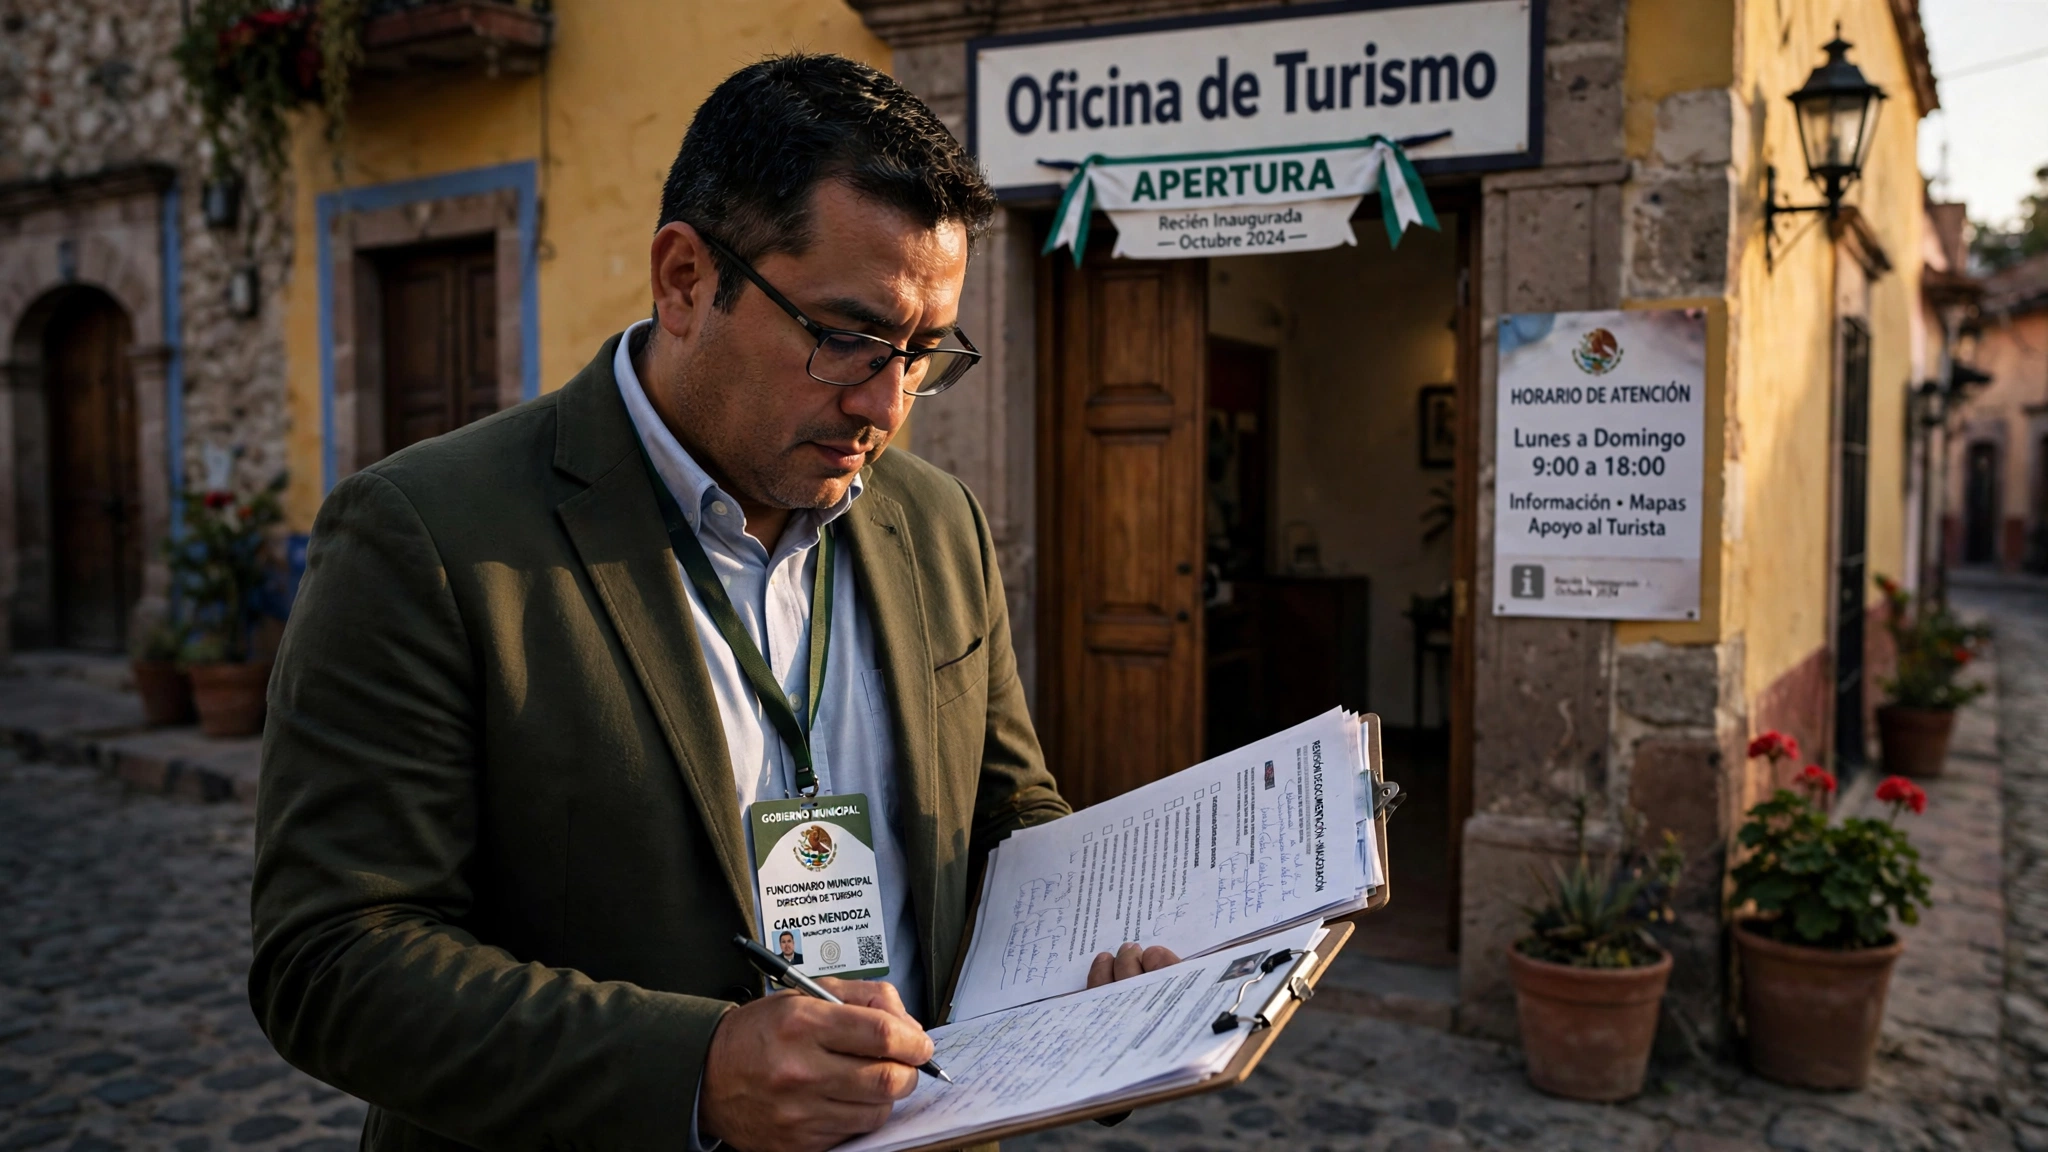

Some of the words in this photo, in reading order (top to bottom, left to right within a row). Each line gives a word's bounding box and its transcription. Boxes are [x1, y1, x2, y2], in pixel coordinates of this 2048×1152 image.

[1007, 66, 1182, 135] Oficina
[1197, 56, 1260, 120] de
[1275, 43, 1497, 114] Turismo
[1131, 158, 1335, 203] APERTURA
[1159, 212, 1208, 231] Recién
[1213, 209, 1303, 230] Inaugurada
[1179, 232, 1243, 250] Octubre
[1247, 230, 1286, 248] 2024
[1511, 387, 1582, 405] HORARIO
[1586, 387, 1606, 404] DE
[1610, 381, 1691, 403] ATENCIÓN
[1514, 428, 1571, 448] Lunes
[1577, 433, 1587, 448] a
[1594, 428, 1686, 452] Domingo
[1532, 456, 1579, 476] 9:00
[1585, 461, 1597, 476] a
[1605, 456, 1666, 476] 18:00
[1510, 493, 1611, 511] Información
[1630, 494, 1686, 515] Mapas
[1528, 517, 1582, 538] Apoyo
[1587, 518, 1602, 535] al
[1607, 518, 1666, 536] Turista
[761, 809, 810, 823] GOBIERNO
[811, 805, 860, 819] MUNICIPAL
[827, 876, 872, 889] MUNICIPAL
[819, 894, 830, 902] DE
[774, 915, 816, 930] CARLOS
[819, 908, 871, 924] MENDOZA
